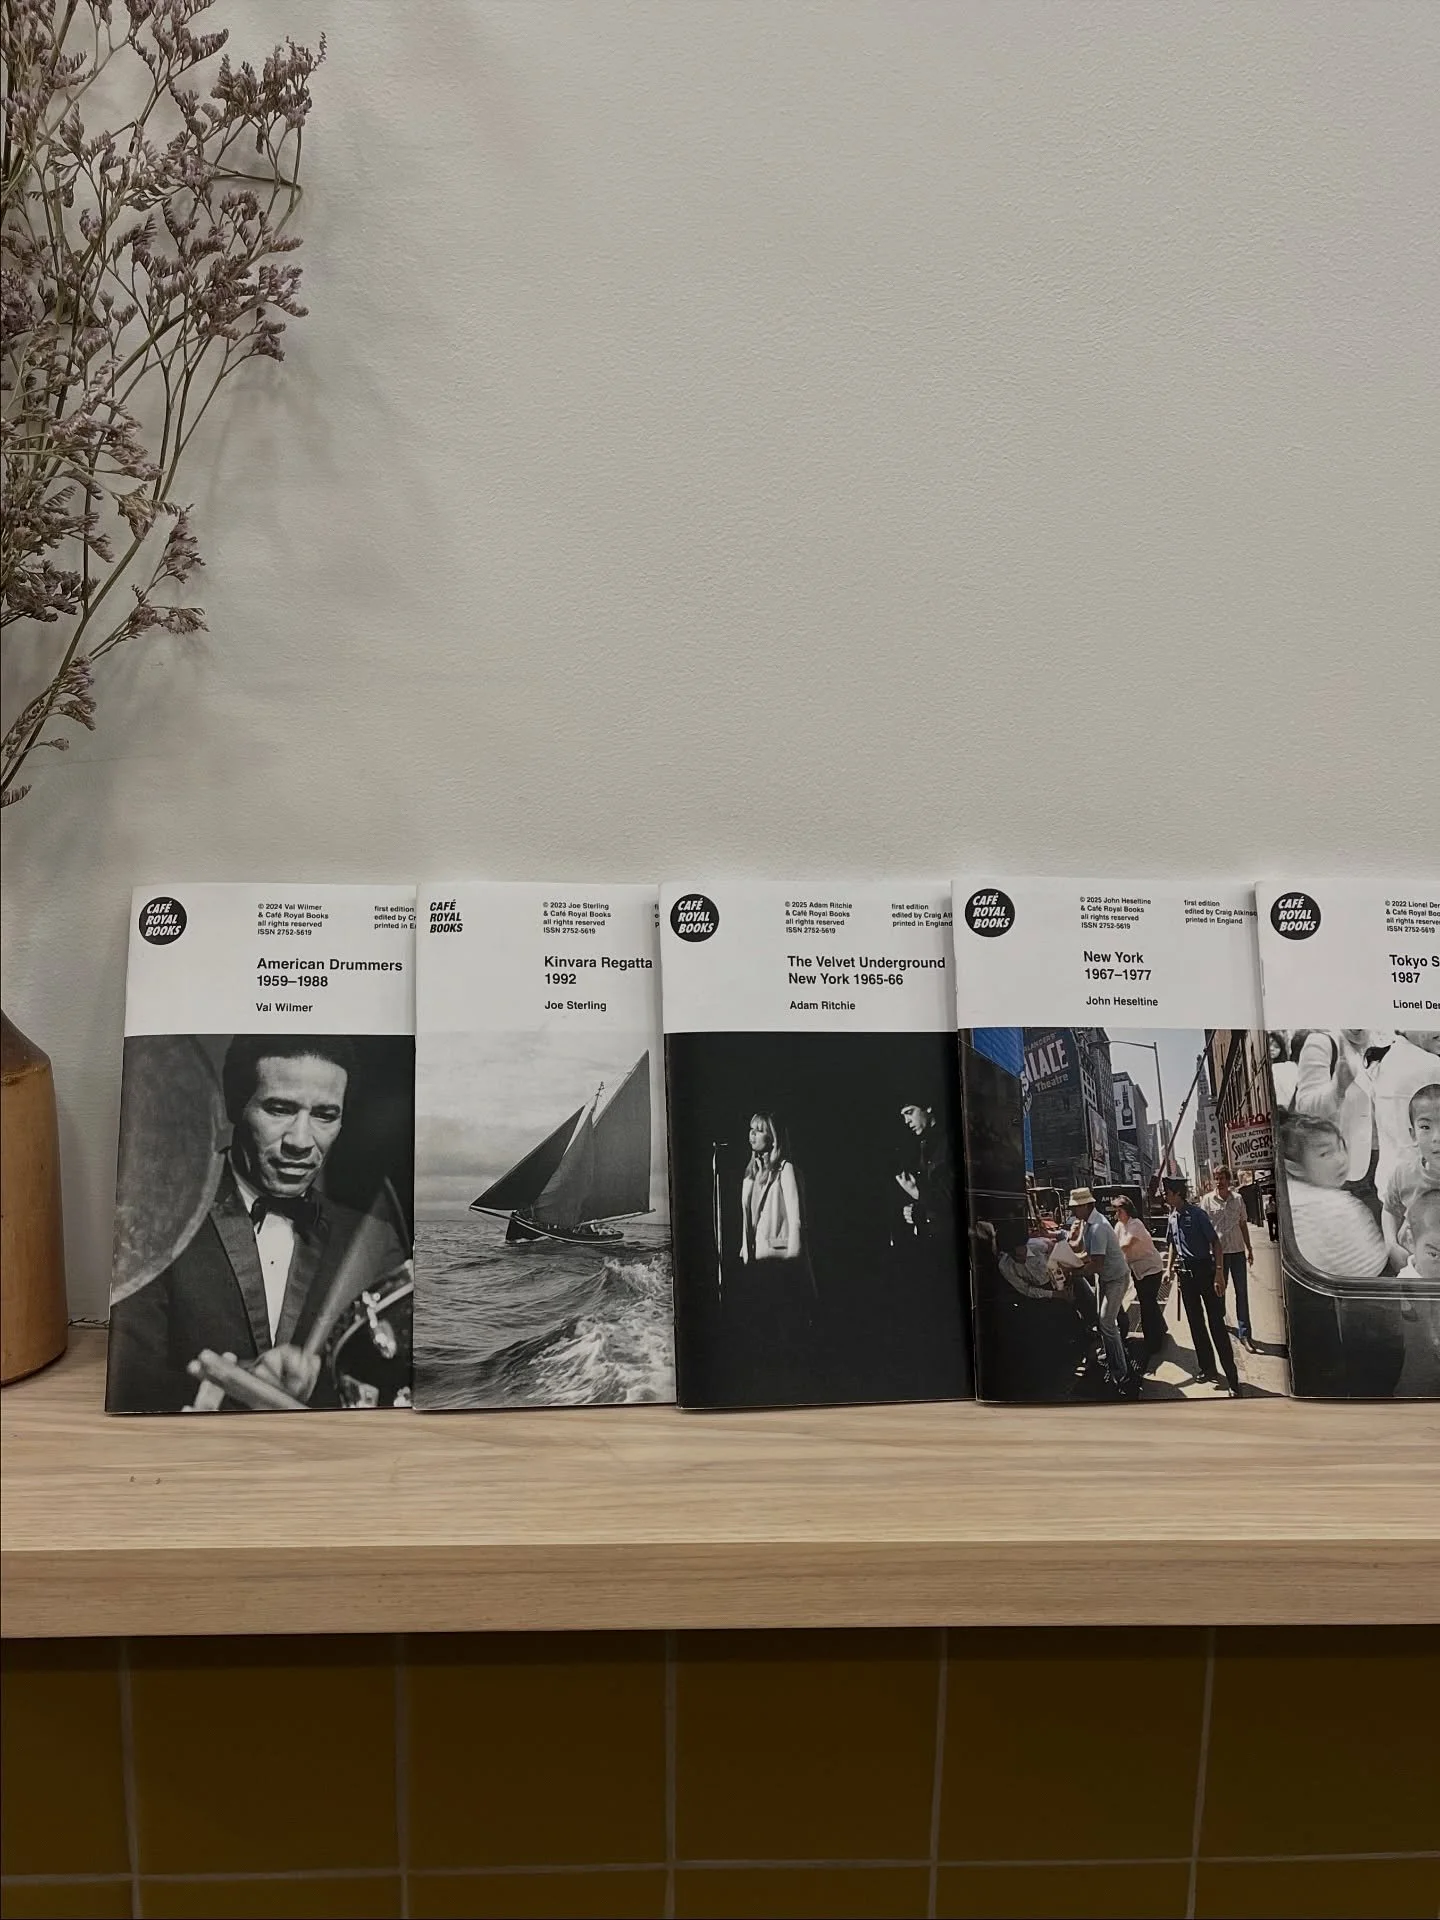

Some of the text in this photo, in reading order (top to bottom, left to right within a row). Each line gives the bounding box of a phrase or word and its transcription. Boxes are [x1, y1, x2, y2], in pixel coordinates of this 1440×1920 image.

[972, 892, 999, 906] CAFÉ
[1103, 897, 1120, 905] John
[1121, 897, 1151, 905] Heseltine
[1278, 896, 1305, 909] CAFÉ
[146, 901, 172, 914] CAFÉ
[284, 903, 296, 911] Val
[297, 903, 322, 911] Wilmer
[374, 905, 414, 913] first edition
[429, 899, 457, 911] CAFÉ
[568, 902, 581, 910] Joe
[582, 902, 609, 911] Sterling
[677, 898, 703, 911] CAFÉ
[791, 901, 808, 909] 2025
[906, 903, 929, 911] edition
[551, 910, 567, 918] Café
[568, 911, 588, 919] Royal
[792, 909, 808, 917] Café
[809, 910, 829, 919] Royal
[830, 910, 850, 918] Books
[972, 906, 1007, 917] ROYAL
[1087, 905, 1102, 913] Café
[1104, 905, 1122, 915] Royal
[1408, 909, 1427, 917] Royal
[145, 914, 178, 925] ROYAL
[265, 911, 282, 919] Café
[283, 912, 304, 921] Royal
[306, 912, 329, 920] Books
[397, 914, 407, 922] by
[429, 912, 462, 922] ROYAL
[678, 911, 710, 922] ROYAL
[891, 911, 913, 919] edited
[914, 912, 922, 920] by
[924, 911, 941, 920] Craig
[1090, 914, 1109, 923] rights
[1278, 910, 1312, 921] ROYAL
[267, 920, 289, 929] rights
[290, 920, 323, 928] reserved
[374, 922, 399, 930] printed
[552, 919, 573, 928] rights
[785, 918, 794, 926] all
[795, 918, 815, 928] rights
[892, 920, 916, 928] printed
[973, 917, 1010, 929] BOOKS
[1099, 922, 1131, 930] 2752-5619
[1216, 917, 1243, 925] England
[144, 925, 182, 937] BOOKS
[429, 923, 463, 933] BOOKS
[562, 927, 596, 935] 2752-5619
[678, 922, 714, 934] BOOKS
[1279, 921, 1316, 932] BOOKS
[277, 928, 312, 936] 2752-5619
[1083, 951, 1144, 964] New York
[1389, 954, 1428, 969] Tokyo
[257, 957, 403, 971] American Drummers
[544, 956, 653, 972] Kinvara Regatta
[787, 955, 946, 972] The Velvet Underground
[544, 973, 577, 985] 1992
[788, 973, 903, 986] New York 1965-66
[1391, 971, 1421, 983] 1987
[544, 1001, 607, 1012] Joe Sterling
[789, 1001, 856, 1010] Adam Ritchie
[1086, 996, 1158, 1007] John Heseltine
[1393, 999, 1422, 1009] Lionel
[256, 1003, 313, 1012] Val Wilmer
[1034, 1073, 1069, 1093] Theatre
